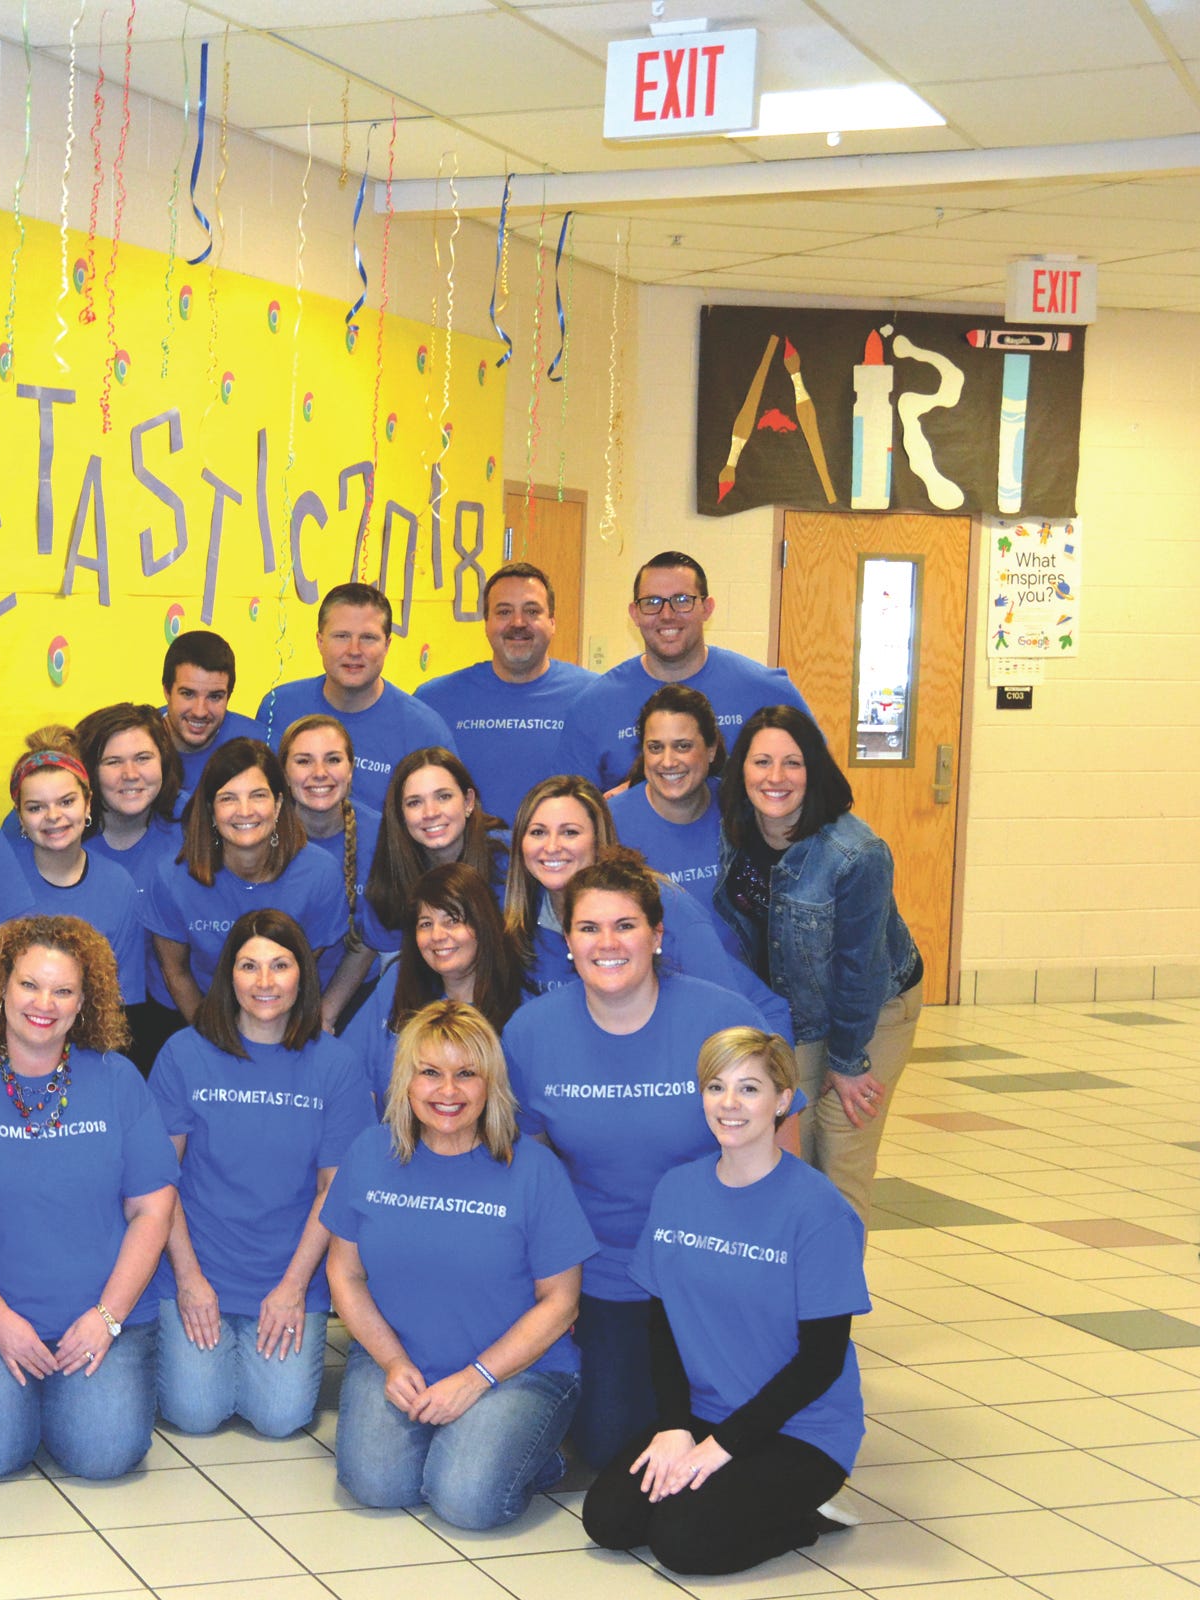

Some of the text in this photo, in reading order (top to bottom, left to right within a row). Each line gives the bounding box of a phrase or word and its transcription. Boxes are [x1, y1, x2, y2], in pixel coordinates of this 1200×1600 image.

[633, 45, 725, 122] EXIT
[1032, 269, 1082, 314] EXIT
[717, 326, 1072, 513] ART
[1015, 552, 1056, 568] What
[1007, 569, 1065, 589] inspires
[1017, 586, 1054, 607] you?
[1006, 692, 1024, 700] C103
[456, 718, 565, 730] #CHROMETASTIC20
[192, 1088, 324, 1110] #CHROMETASTIC218
[544, 1080, 696, 1099] #CHROMETASTIC2018
[366, 1190, 507, 1218] #CHROMETASTIC2018
